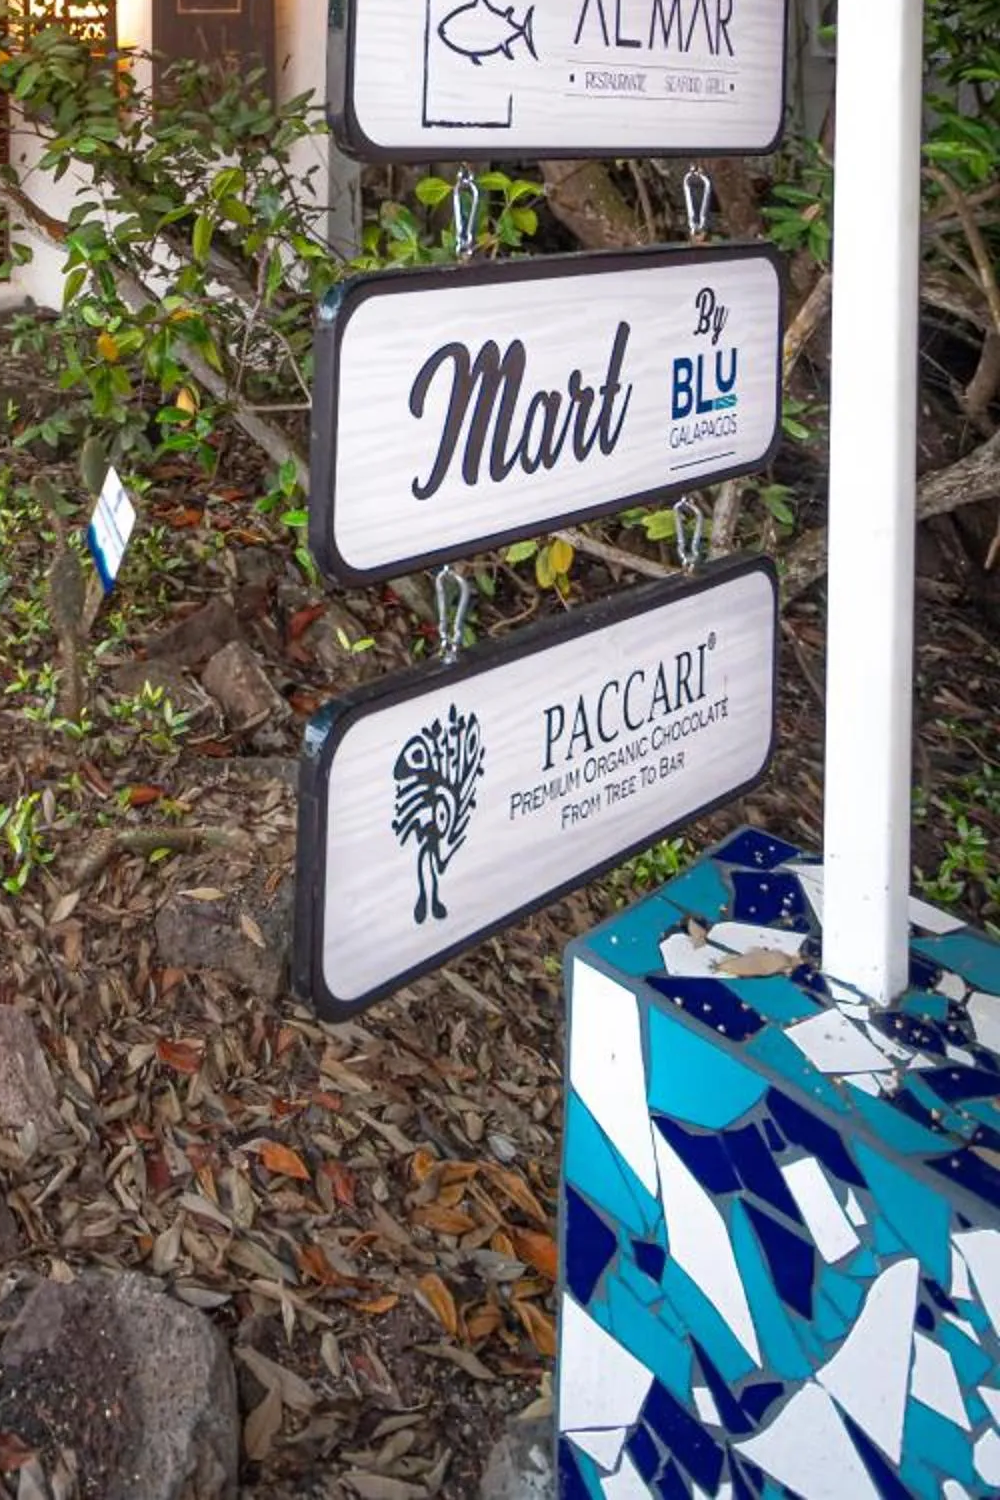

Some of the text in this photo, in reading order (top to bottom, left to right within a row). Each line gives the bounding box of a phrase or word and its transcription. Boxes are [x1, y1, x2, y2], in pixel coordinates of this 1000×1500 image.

[693, 287, 730, 346] By
[408, 321, 633, 500] Mart
[672, 348, 738, 420] BLU
[670, 414, 738, 449] GALAPAGOS
[509, 697, 729, 820] PREMIUM ORGANIC CHOCOLATE
[561, 790, 601, 829] FROM
[604, 774, 637, 805] TREE
[659, 751, 686, 779] BAR
